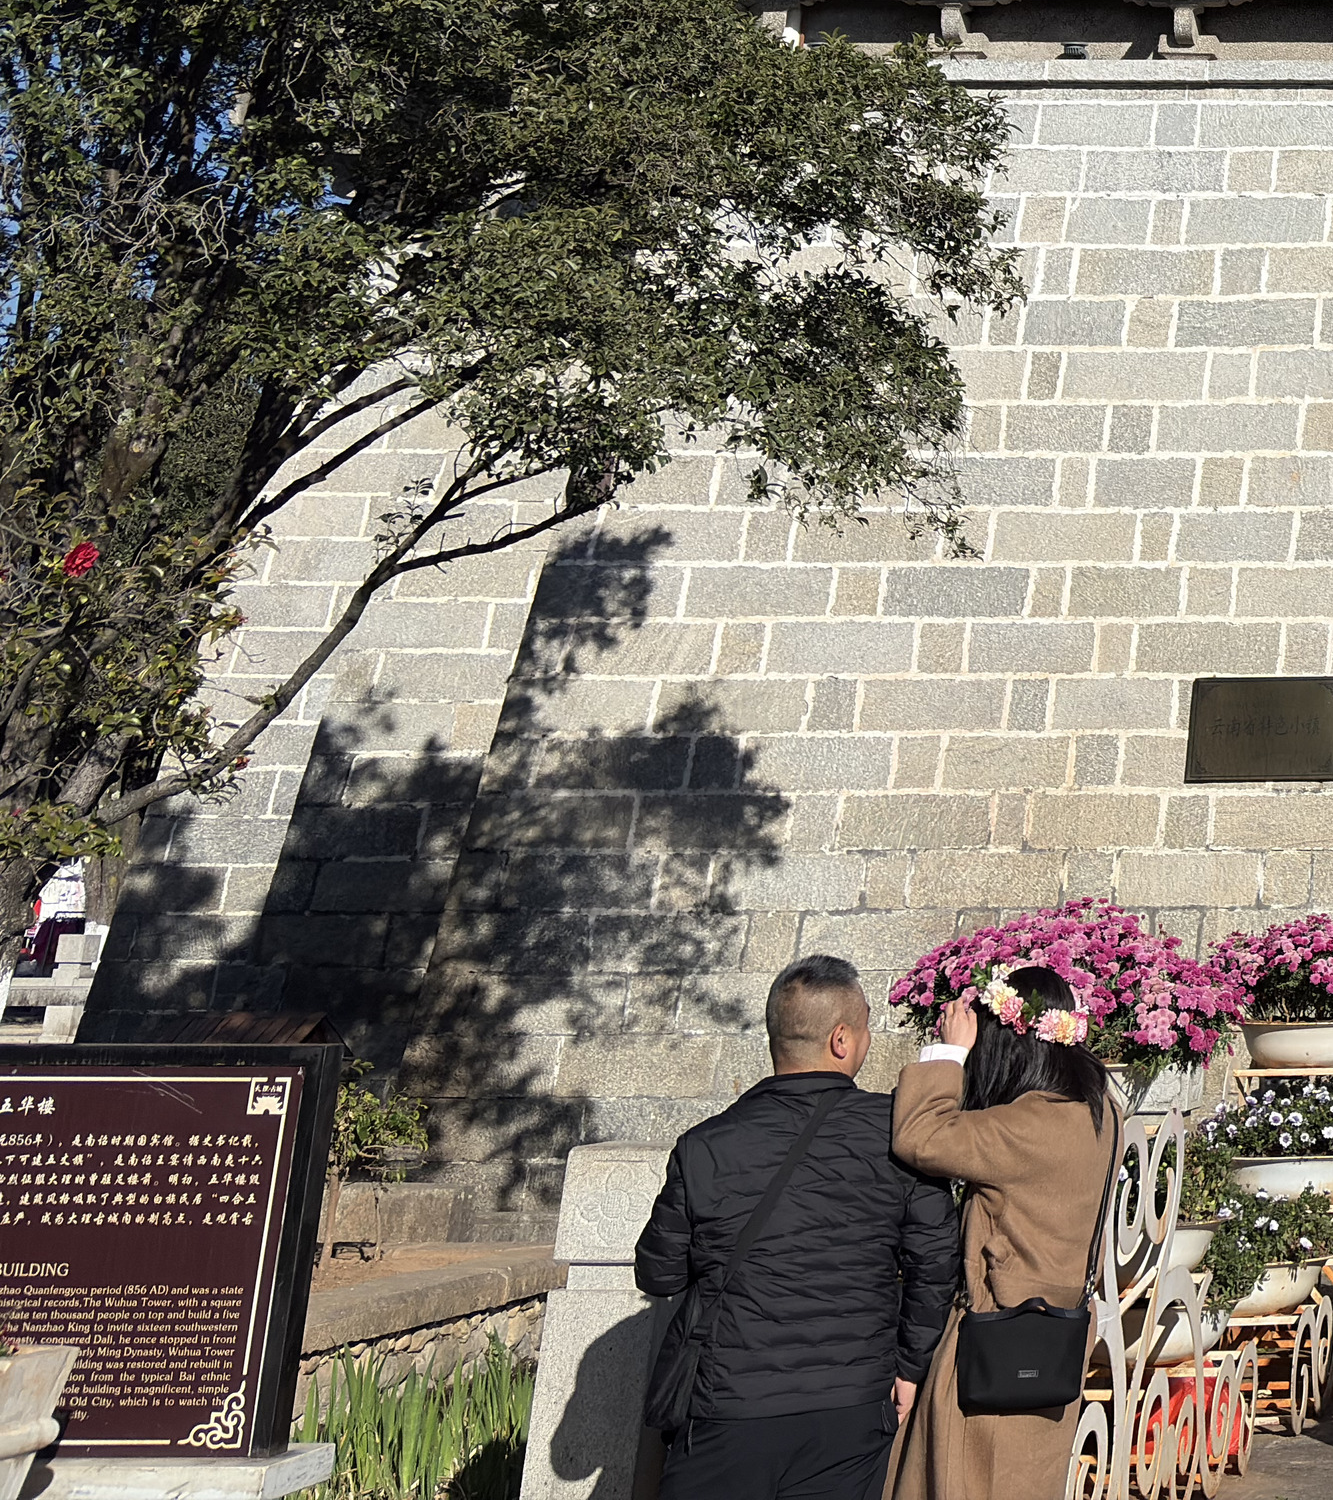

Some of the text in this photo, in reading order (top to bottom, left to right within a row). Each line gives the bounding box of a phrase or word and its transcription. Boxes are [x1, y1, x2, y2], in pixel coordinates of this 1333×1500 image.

[0, 1096, 56, 1115] 五华楼
[0, 1263, 70, 1277] UILDING
[23, 1285, 88, 1296] Quanfengyou
[90, 1285, 122, 1296] period
[124, 1285, 147, 1296] (856
[149, 1285, 170, 1294] AD)
[171, 1285, 190, 1294] and
[220, 1285, 244, 1294] state
[105, 1298, 138, 1307] Wuhua
[141, 1298, 175, 1309] Tower,
[178, 1298, 199, 1307] with
[210, 1300, 242, 1309] square
[32, 1310, 48, 1319] ten
[50, 1310, 95, 1319] thousand
[97, 1310, 130, 1321] people
[148, 1310, 165, 1321] top
[166, 1310, 185, 1319] and
[187, 1310, 212, 1319] build
[222, 1310, 240, 1319] five
[22, 1323, 65, 1332] Nanzhao
[67, 1323, 91, 1334] King
[94, 1323, 104, 1332] to
[107, 1323, 134, 1332] invite
[137, 1323, 172, 1332] sixteen
[175, 1323, 239, 1332] southwestern
[40, 1335, 91, 1346] conquered
[93, 1335, 117, 1346] Dali,
[119, 1335, 131, 1344] he
[159, 1335, 199, 1346] stopped
[201, 1335, 210, 1344] in
[212, 1335, 237, 1344] front
[98, 1347, 121, 1358] Ming
[123, 1347, 166, 1358] Dynasty,
[168, 1347, 201, 1356] Wuhua
[203, 1347, 236, 1356] Tower
[106, 1361, 125, 1369] was
[126, 1360, 167, 1369] restored
[169, 1360, 187, 1369] and
[189, 1360, 221, 1369] rebuilt
[223, 1360, 233, 1369] in
[68, 1372, 232, 1383] ion from the typical Bai ethnic
[82, 1385, 121, 1395] building
[124, 1385, 132, 1394] is
[134, 1385, 195, 1395] magnificent,
[197, 1385, 230, 1395] simple
[70, 1397, 88, 1406] Old
[92, 1397, 116, 1408] City,
[119, 1397, 148, 1406] which
[152, 1397, 161, 1406] is
[164, 1397, 175, 1406] to
[178, 1397, 208, 1406] watch
